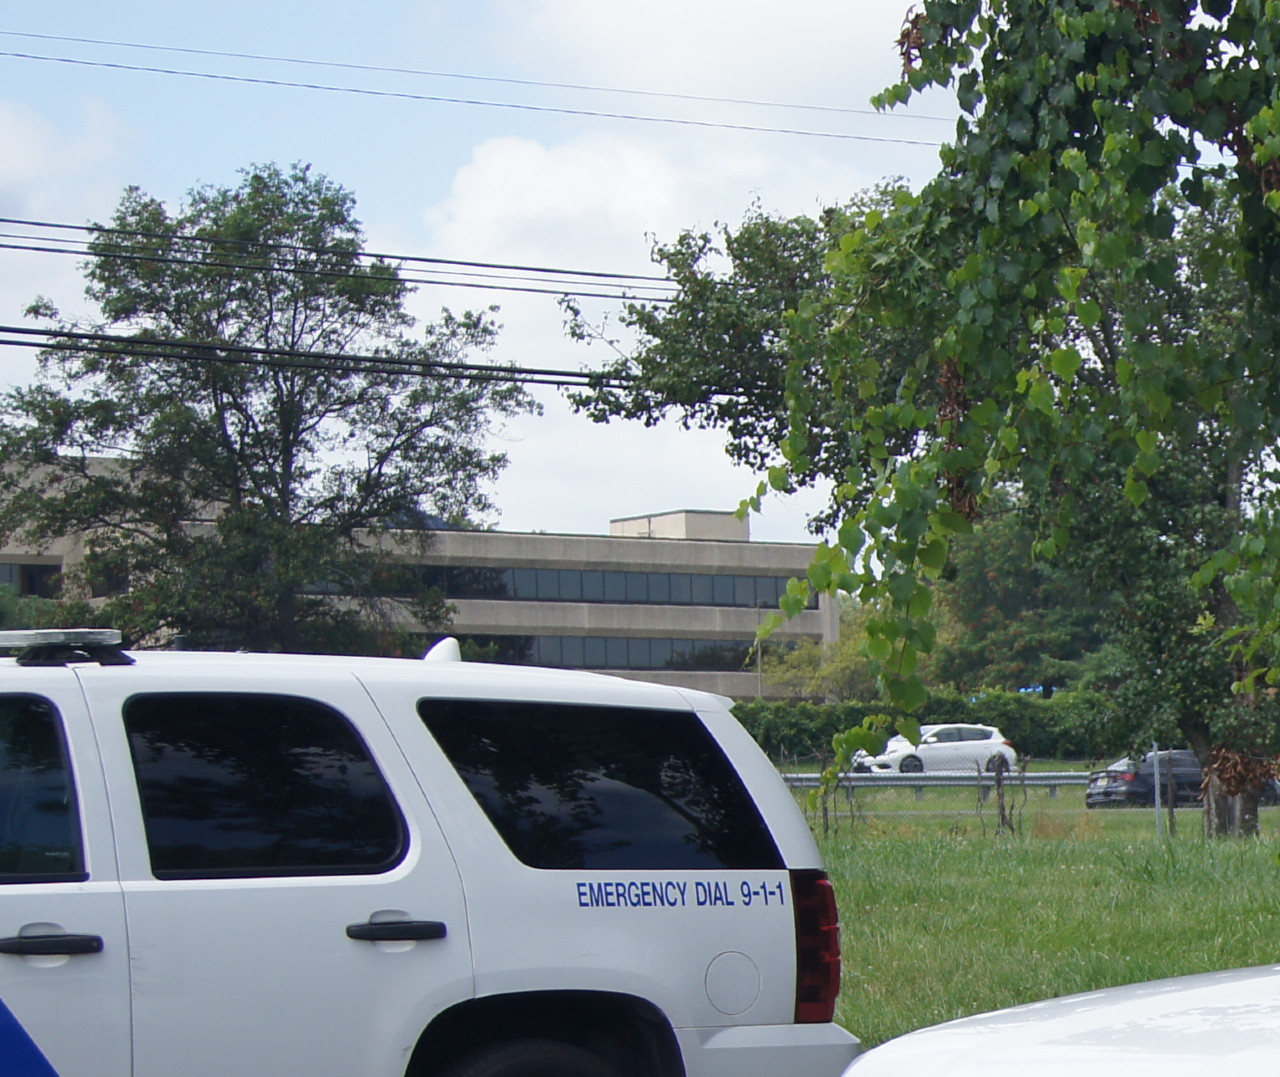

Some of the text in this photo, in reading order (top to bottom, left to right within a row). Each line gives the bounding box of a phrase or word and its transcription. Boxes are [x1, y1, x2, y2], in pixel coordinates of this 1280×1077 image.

[576, 880, 785, 907] EMERGENCY DIAL 9-1-1
